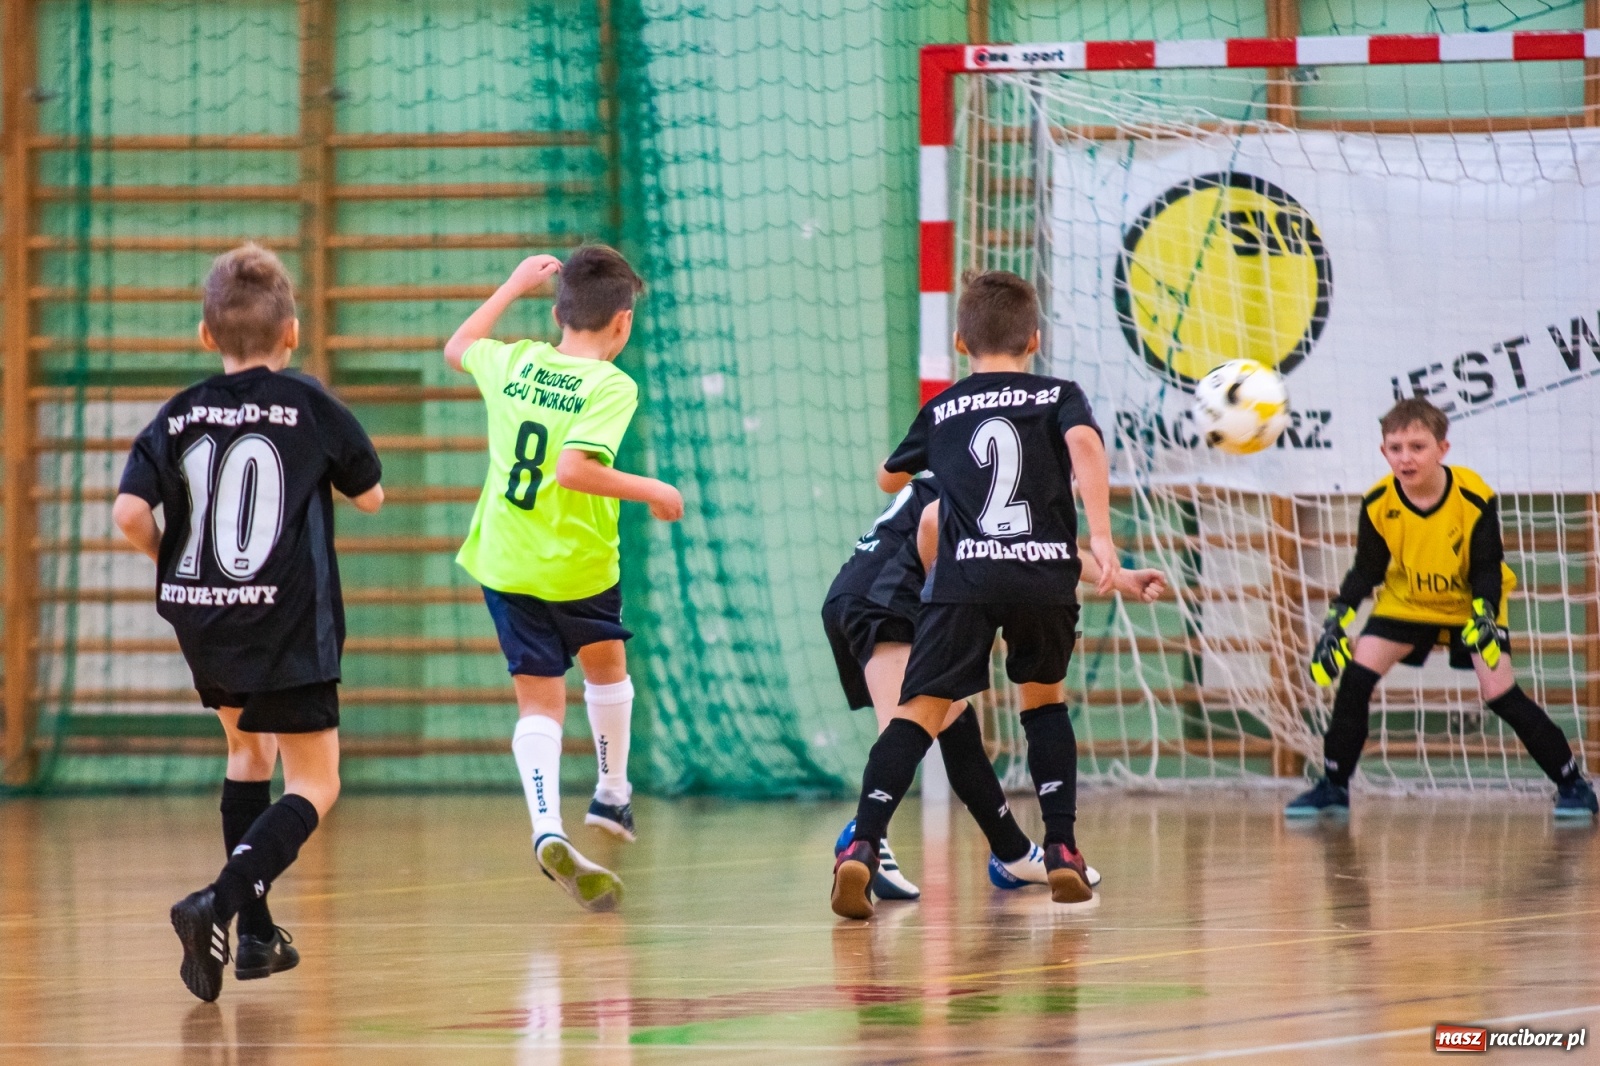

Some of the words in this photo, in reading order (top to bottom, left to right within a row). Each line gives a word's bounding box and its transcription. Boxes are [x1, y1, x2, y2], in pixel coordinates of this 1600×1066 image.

[1022, 49, 1066, 65] sport
[168, 403, 298, 436] NPRZÓD-23
[532, 387, 587, 414] TWORKÓW
[933, 386, 1062, 425] NAPRZÓD-23
[1115, 409, 1333, 449] RACRZ
[505, 420, 548, 511] 8
[968, 416, 1033, 539] 2
[174, 433, 285, 581] 10
